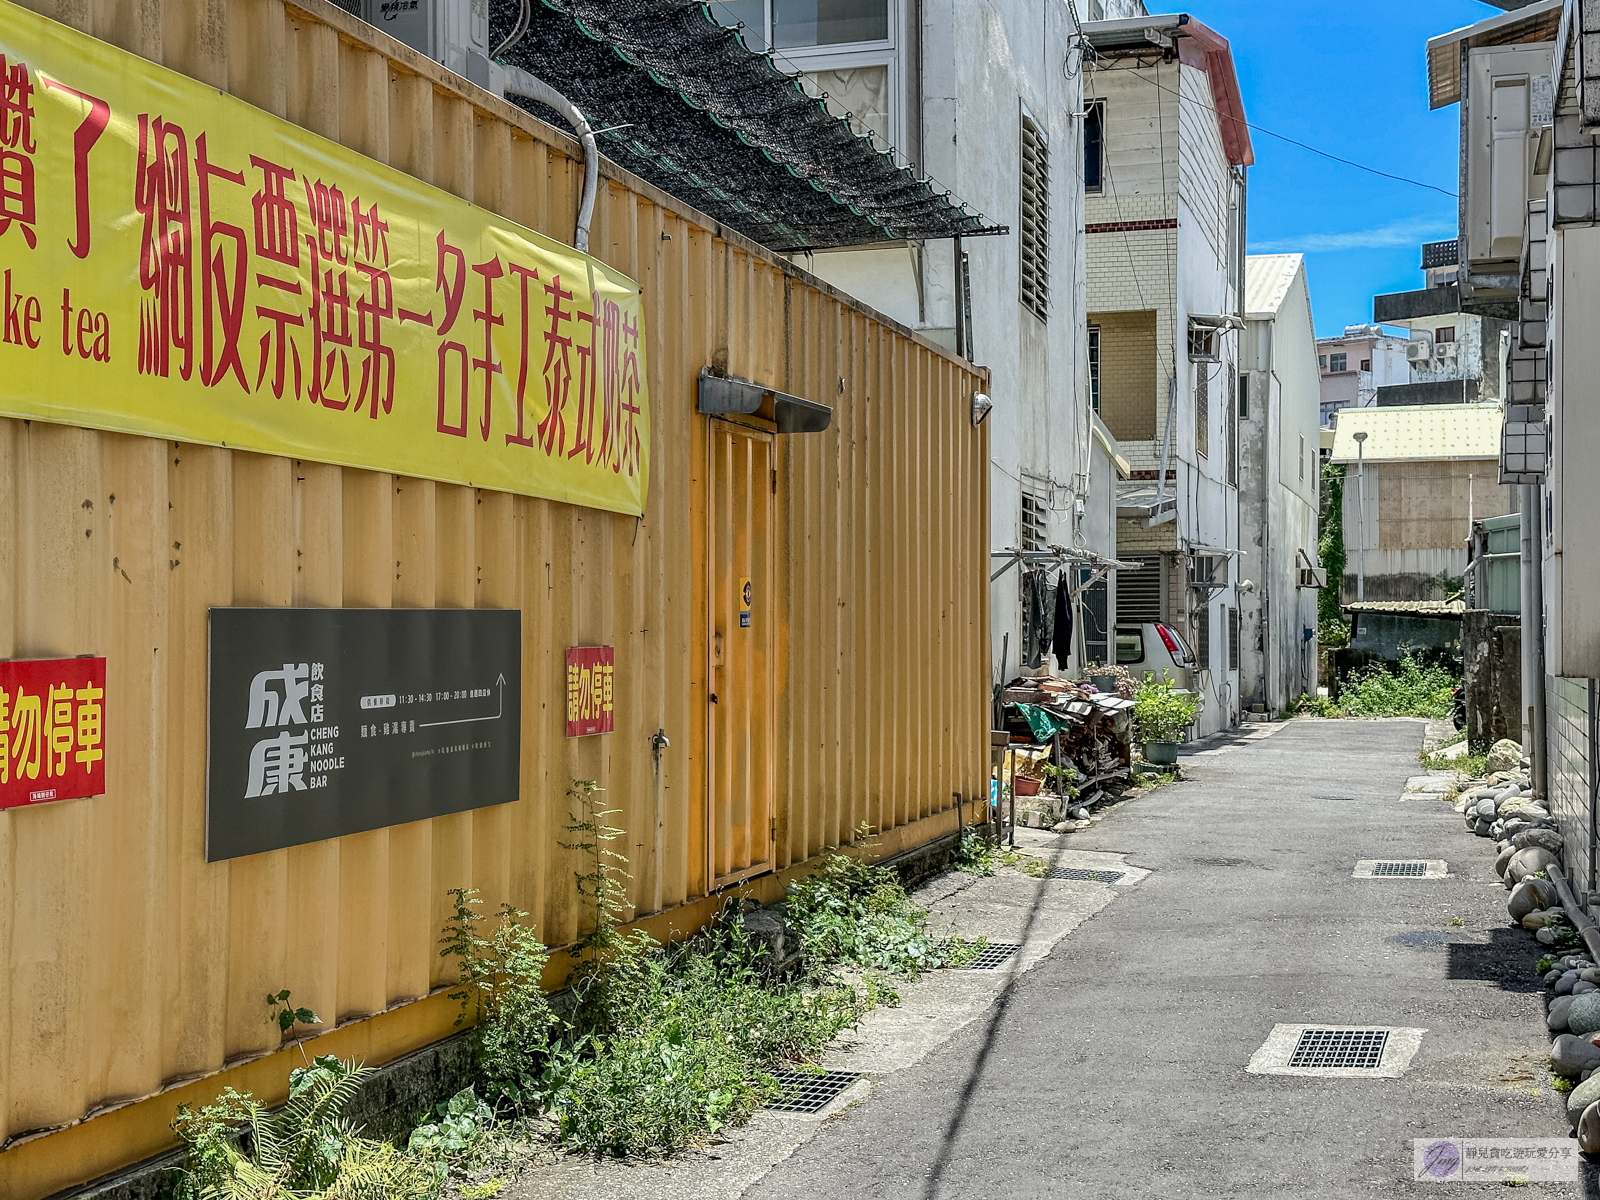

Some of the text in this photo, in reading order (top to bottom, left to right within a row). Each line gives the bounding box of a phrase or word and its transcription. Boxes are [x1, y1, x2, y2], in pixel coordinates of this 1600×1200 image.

[60, 287, 111, 364] tea
[310, 662, 324, 723] 飲食店
[398, 694, 414, 704] 11:30
[418, 692, 433, 703] 14:30
[435, 691, 450, 701] 17:00
[568, 660, 613, 722] 請勿停車
[244, 662, 309, 799] 成康
[310, 725, 340, 741] CHENG
[310, 742, 334, 757] KANG
[310, 756, 345, 773] NOODLE
[310, 775, 328, 790] BAR
